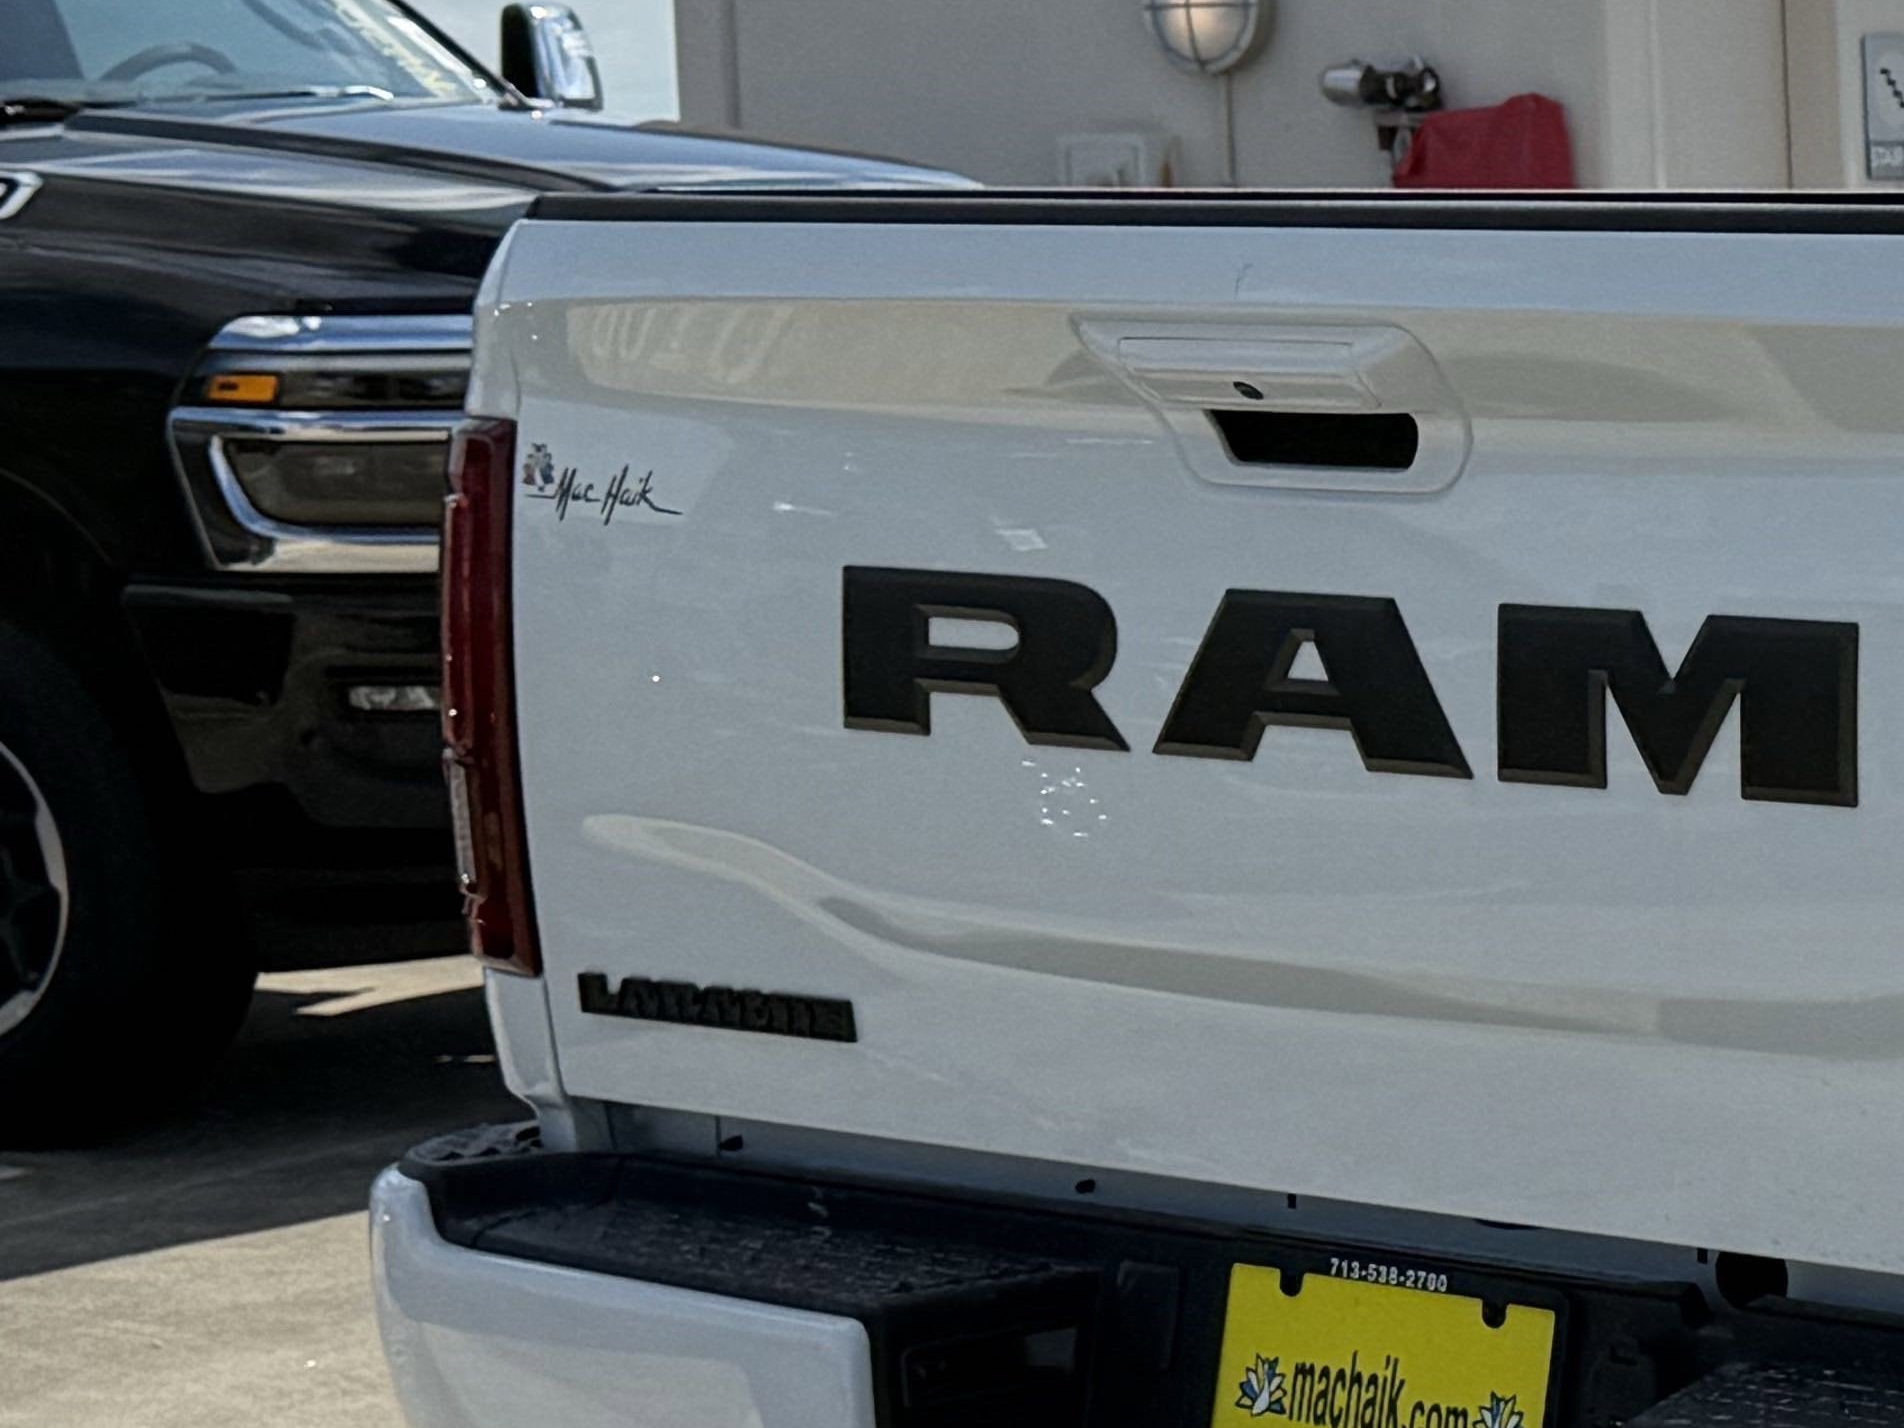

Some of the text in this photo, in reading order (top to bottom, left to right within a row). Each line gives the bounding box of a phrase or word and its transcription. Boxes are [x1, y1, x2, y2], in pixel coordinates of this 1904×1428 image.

[526, 464, 683, 525] Mac Haik
[842, 565, 1858, 807] RAM
